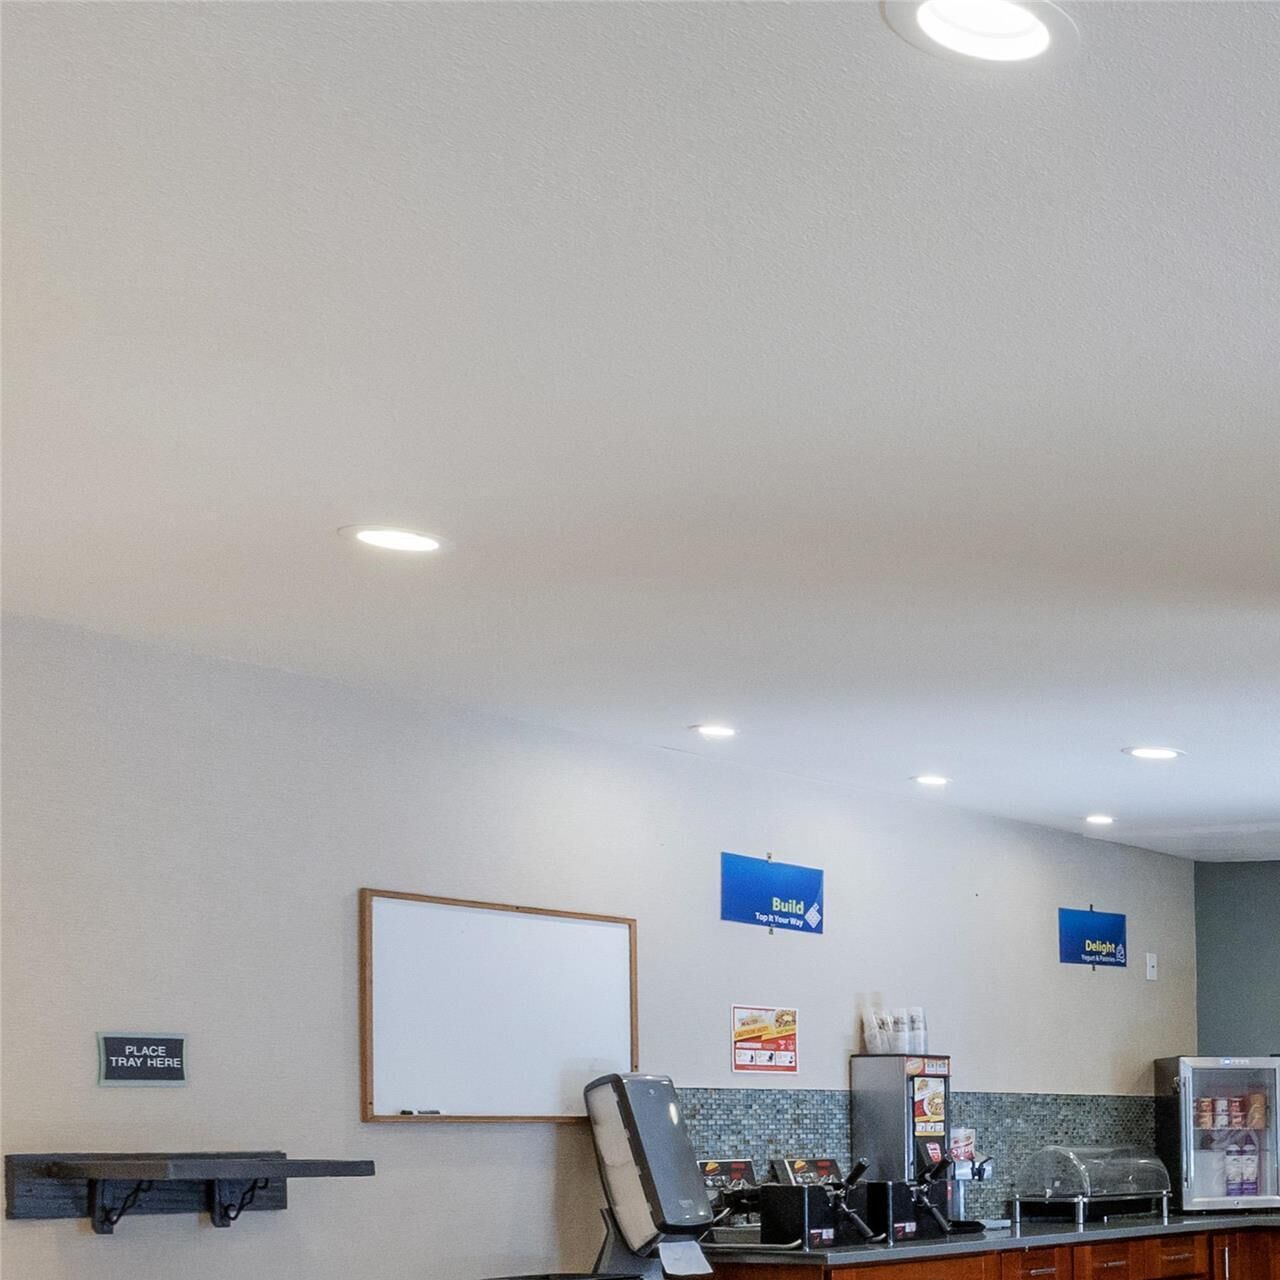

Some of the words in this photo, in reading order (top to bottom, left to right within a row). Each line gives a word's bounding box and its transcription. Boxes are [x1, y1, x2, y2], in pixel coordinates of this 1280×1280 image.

[772, 897, 804, 915] Build
[755, 912, 768, 923] Top
[774, 915, 790, 924] Your
[790, 917, 804, 928] Way
[1085, 939, 1116, 955] Delight
[125, 1045, 167, 1056] PLACE
[109, 1056, 144, 1067] TRAY
[147, 1057, 182, 1068] HERE
